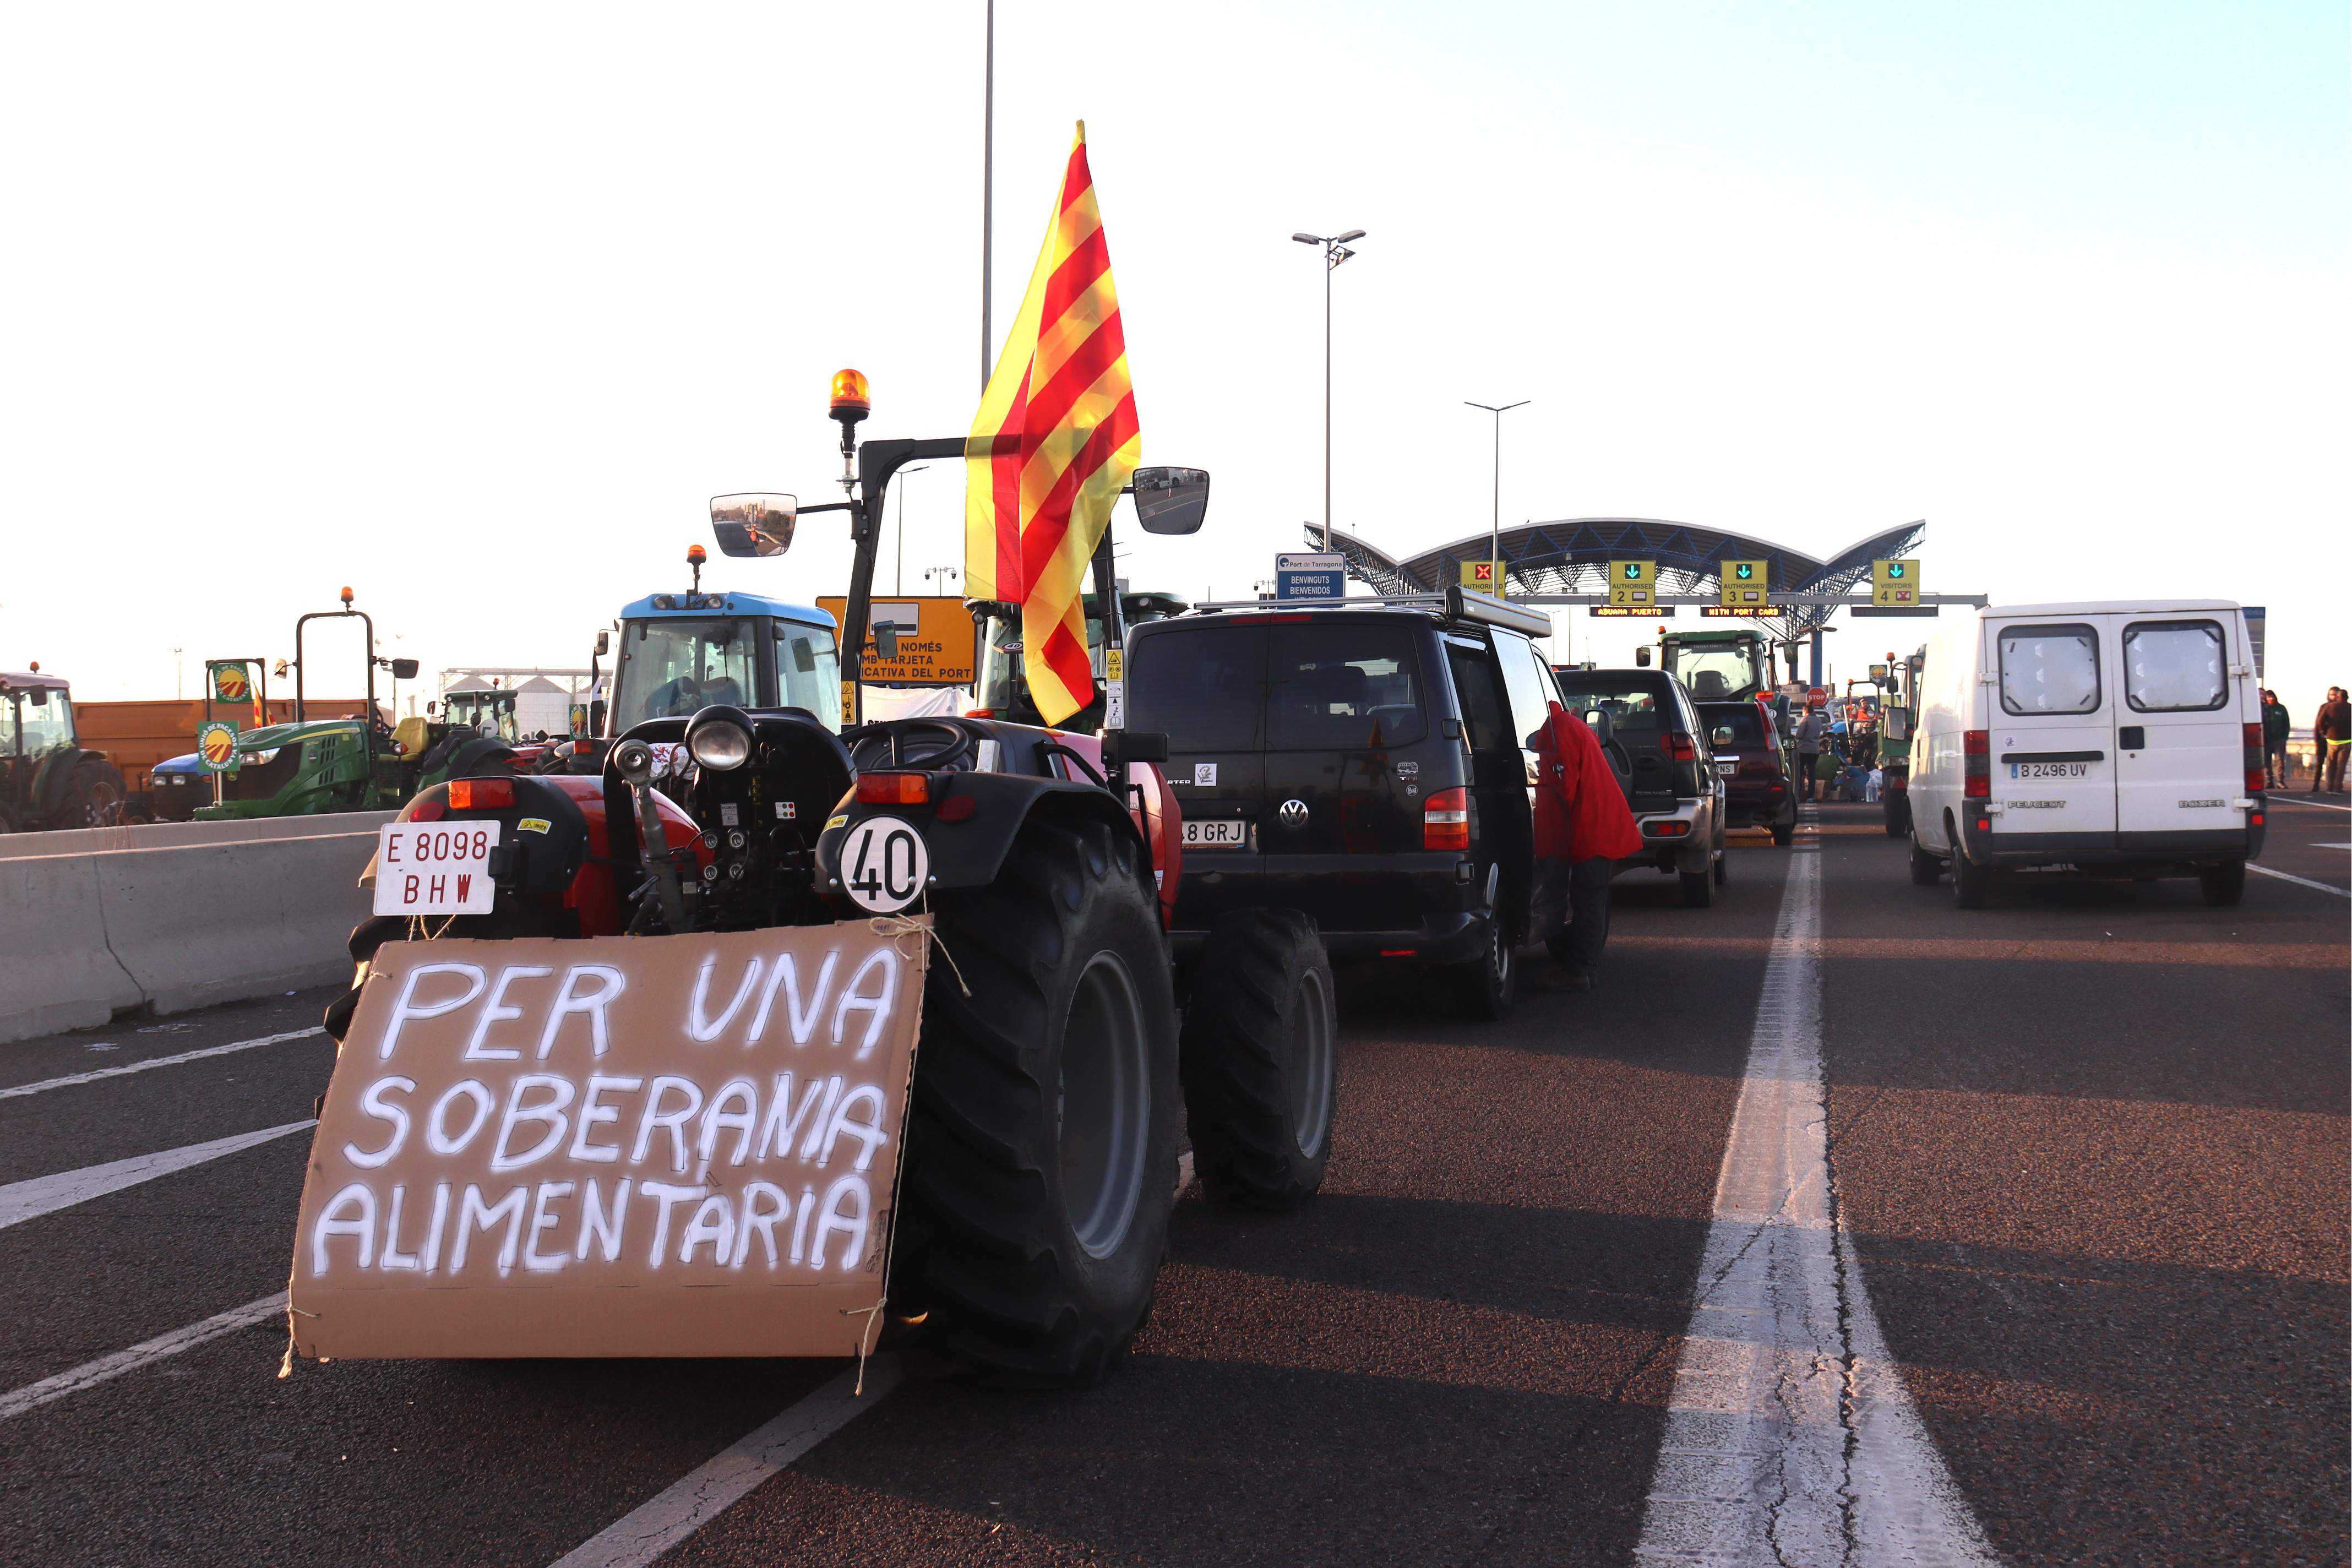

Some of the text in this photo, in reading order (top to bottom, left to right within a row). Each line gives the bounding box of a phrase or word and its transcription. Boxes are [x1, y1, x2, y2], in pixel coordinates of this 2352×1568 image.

[1290, 586, 1330, 595] BIENVENIDOS
[1880, 591, 1888, 601] 4
[1618, 591, 1625, 602] 2
[1729, 591, 1736, 602] 3
[901, 641, 942, 652] NOMÉS
[862, 655, 877, 664] MB
[862, 667, 971, 678] ICATIVA DEL PORT
[216, 723, 238, 747] PAGESOS
[200, 749, 237, 769] DE CATALUNYA
[2021, 764, 2087, 777] B 2496 UV
[2008, 801, 2066, 809] PEUGEOT
[2179, 799, 2225, 808] BOXER
[1182, 823, 1240, 841] 8 GRJ
[388, 831, 487, 862] E 8098
[851, 829, 916, 901] 40
[379, 948, 901, 1061] PER UNA
[341, 1070, 889, 1173] SOBERANIA
